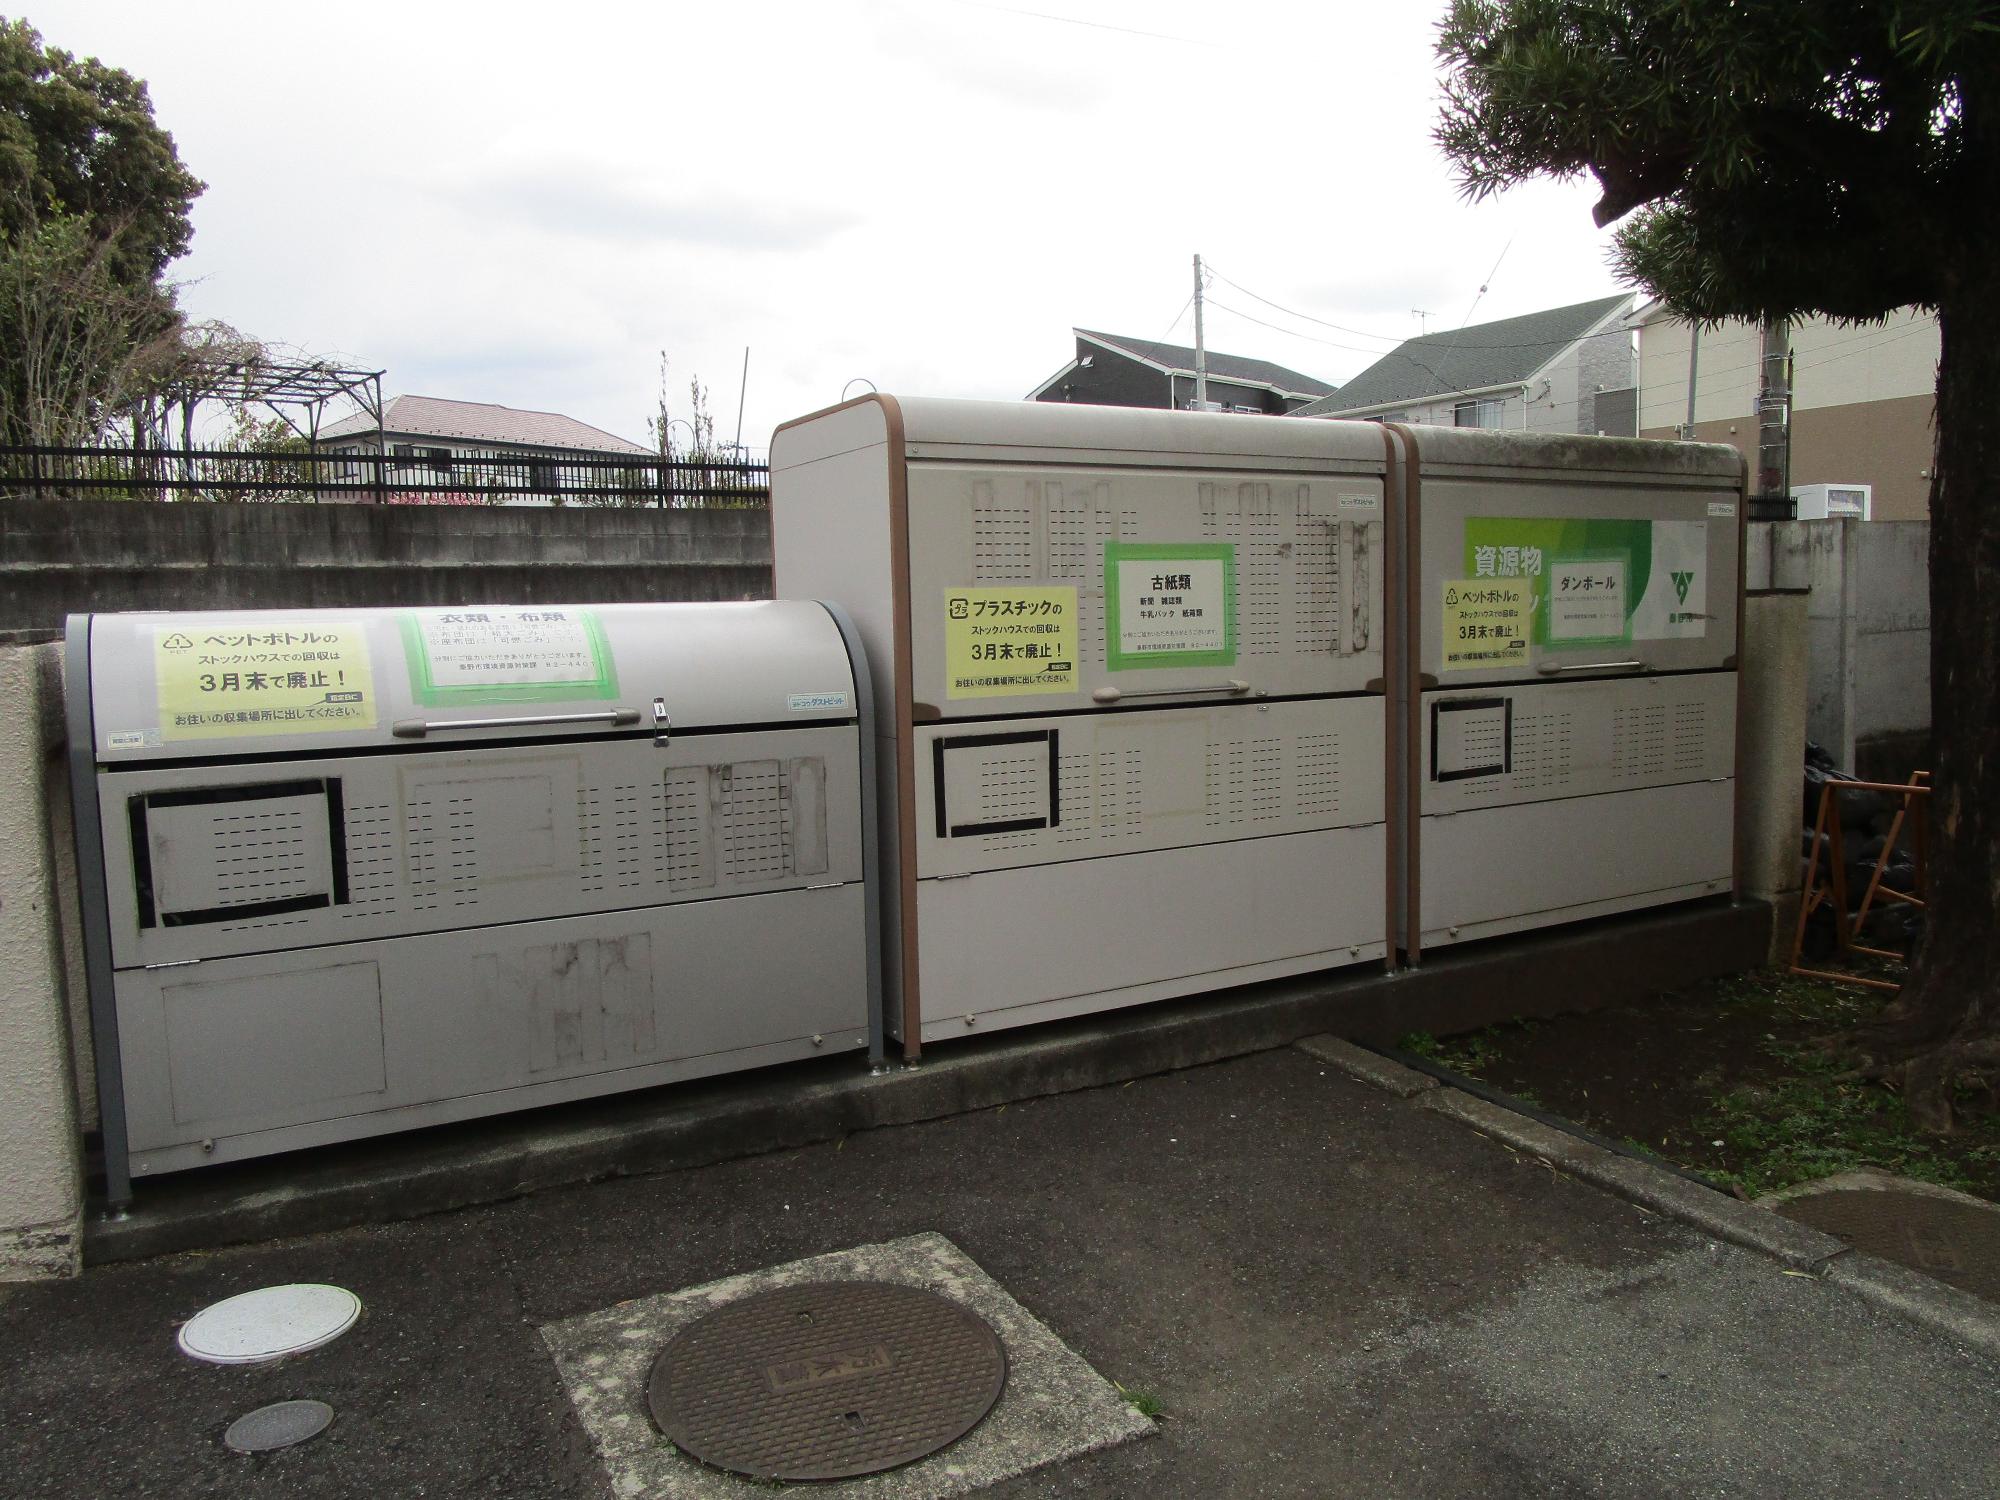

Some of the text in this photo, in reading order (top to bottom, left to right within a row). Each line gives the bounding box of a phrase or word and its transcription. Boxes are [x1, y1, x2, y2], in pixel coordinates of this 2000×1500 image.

[1474, 545, 1542, 577] 資源物
[1151, 574, 1191, 591] 古紙類
[1561, 576, 1616, 591] ダンボール
[1463, 590, 1519, 604] ペットボトルの
[973, 599, 1063, 617] プラスチックの
[1140, 610, 1175, 619] 牛乳パック
[439, 612, 567, 624] 衣類・布類
[971, 623, 1060, 635] ストックハウスでの回収は
[1459, 625, 1519, 640] 3月末で廃止！
[204, 632, 339, 647] ペットボトルの
[198, 651, 341, 665] ストックハウスでの回収は
[971, 643, 1061, 660] 3月末で廃止！
[199, 670, 346, 692] 3月末で廃止！
[175, 707, 362, 726] お住いの収集場所に出してください。
